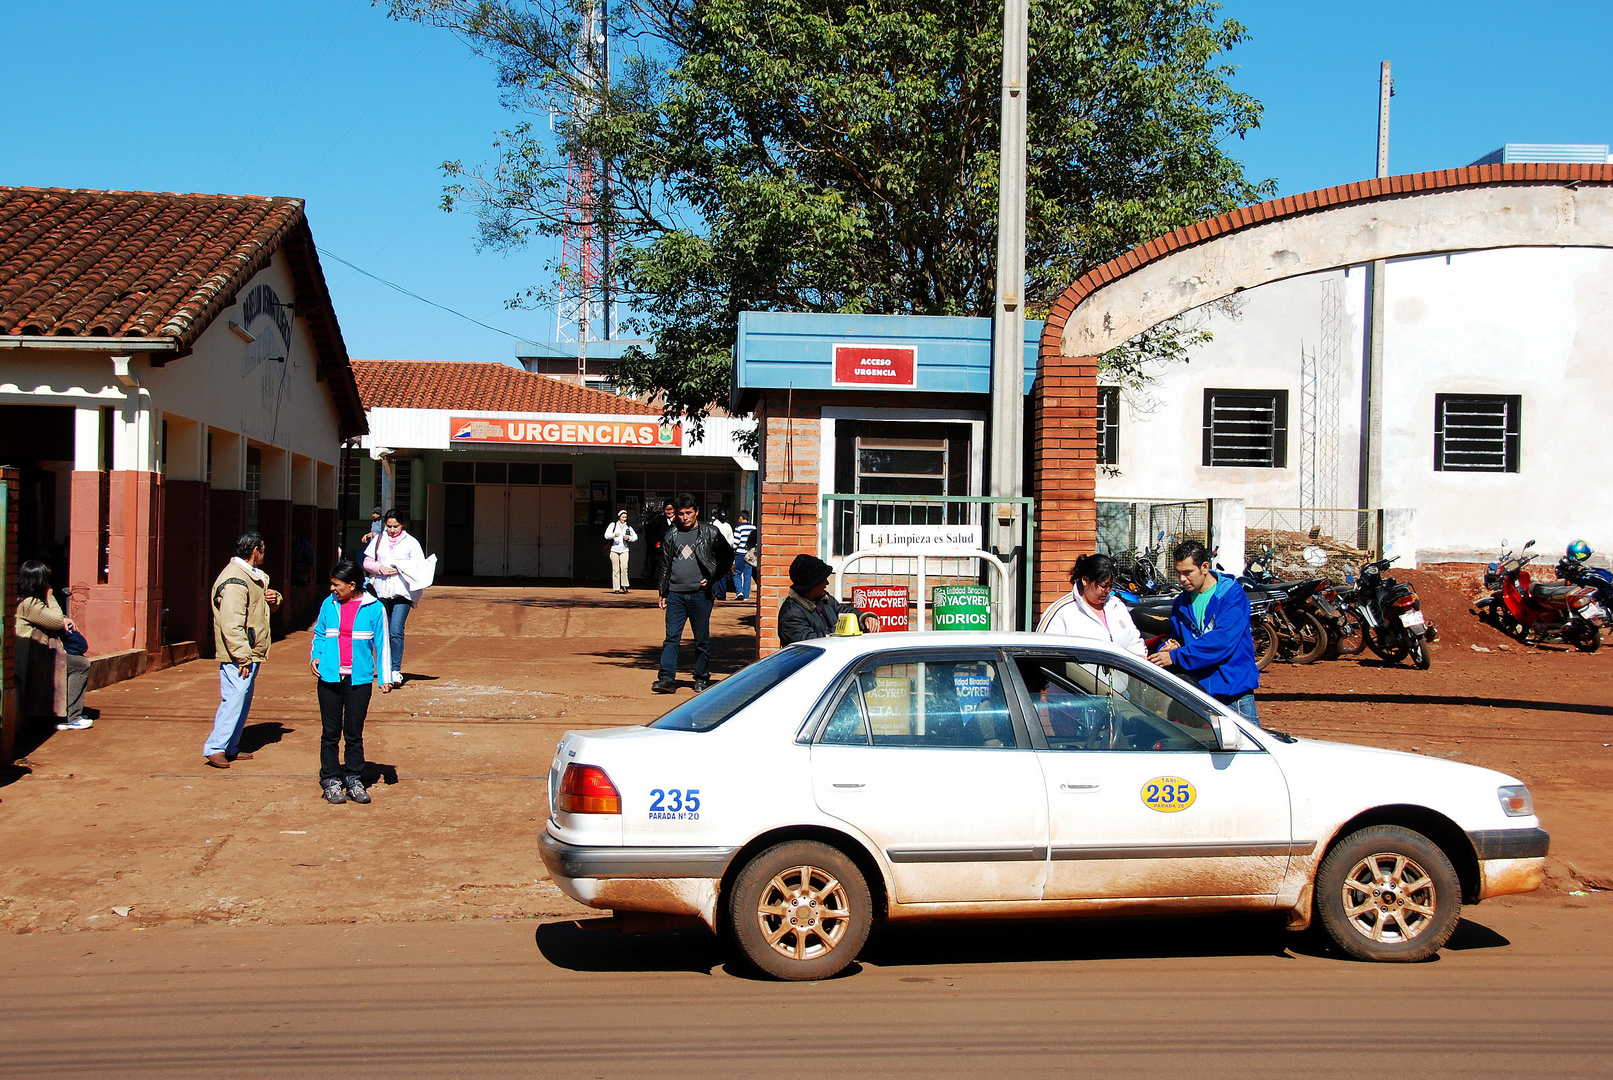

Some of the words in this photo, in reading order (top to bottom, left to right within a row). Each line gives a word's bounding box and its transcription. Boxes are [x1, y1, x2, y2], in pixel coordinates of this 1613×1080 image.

[860, 358, 891, 366] ACCESO
[854, 368, 896, 377] URGENCIA
[507, 422, 654, 445] URGENCIAS
[870, 533, 883, 544] La
[886, 533, 931, 547] Limpieza
[934, 535, 943, 544] es
[946, 533, 974, 544] Salud
[867, 588, 887, 597] Entidad
[946, 586, 966, 595] Entidad
[867, 597, 908, 609] YACYRETA
[946, 595, 990, 606] YACYRETA
[877, 615, 908, 626] TICOS
[935, 613, 987, 625] VIDRIOS
[1146, 784, 1190, 803] 235
[649, 788, 701, 812] 235
[688, 812, 700, 820] 20
